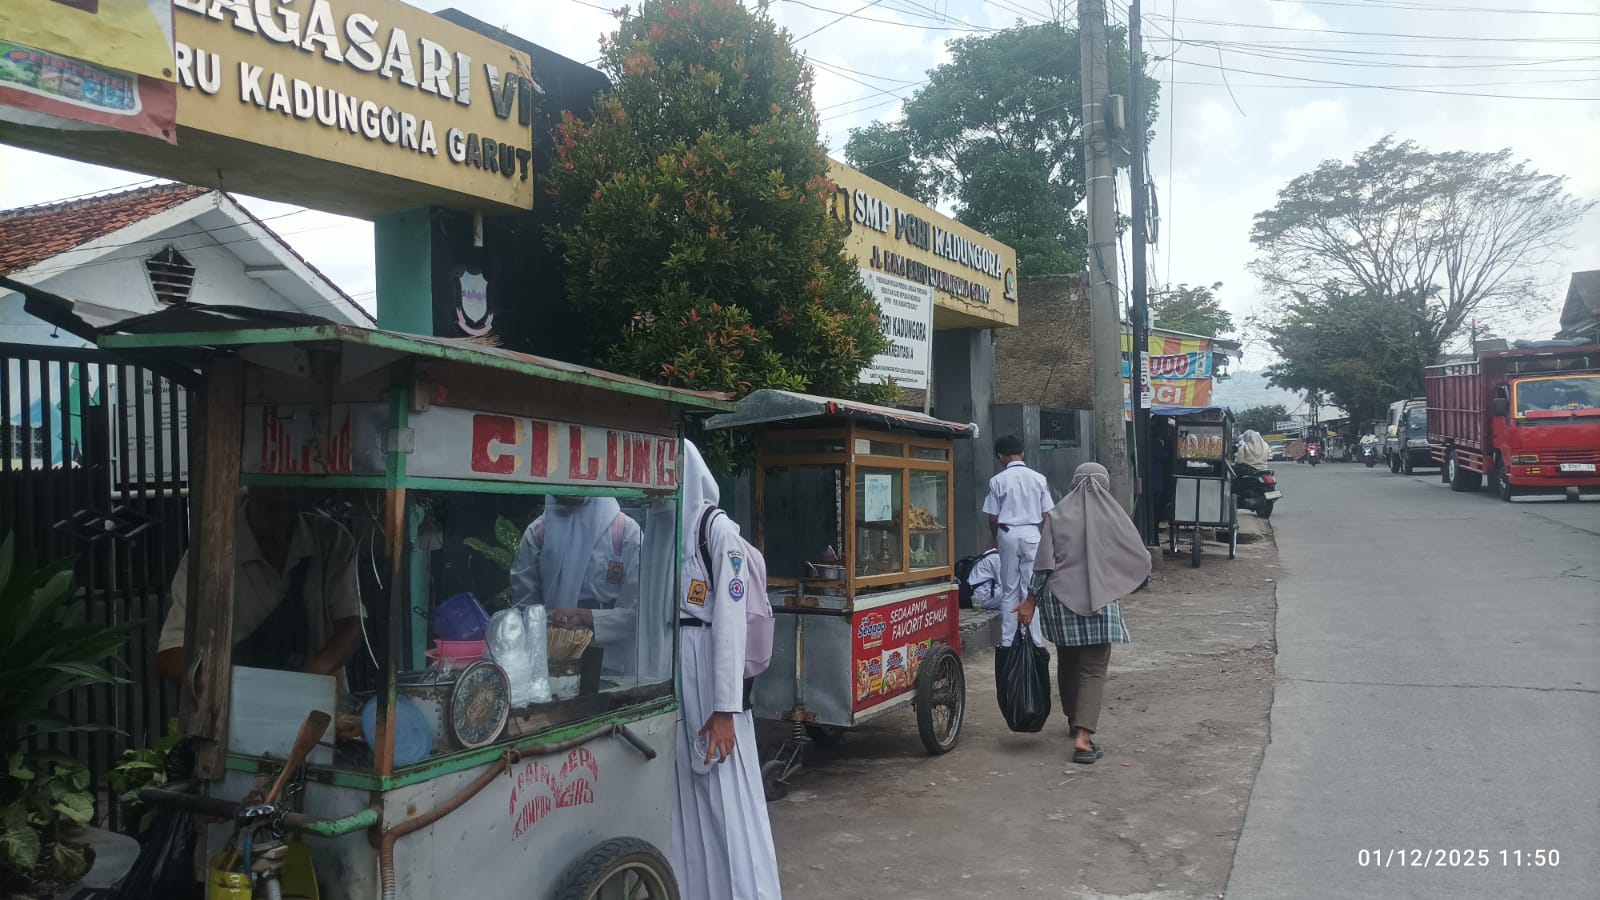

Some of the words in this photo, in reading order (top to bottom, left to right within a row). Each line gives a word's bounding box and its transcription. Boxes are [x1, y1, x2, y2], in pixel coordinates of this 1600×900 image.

[240, 60, 438, 156] KADUNGORA
[448, 127, 532, 181] GARUT
[484, 63, 531, 127] VI
[853, 188, 892, 233] SMP
[932, 225, 1003, 280] KADUNGORA
[893, 316, 927, 341] KADUNGORA
[472, 413, 676, 486] CILUNG
[889, 600, 928, 624] SEDAAPNYA
[891, 615, 923, 640] FAVORIT
[924, 606, 948, 628] SEMUA
